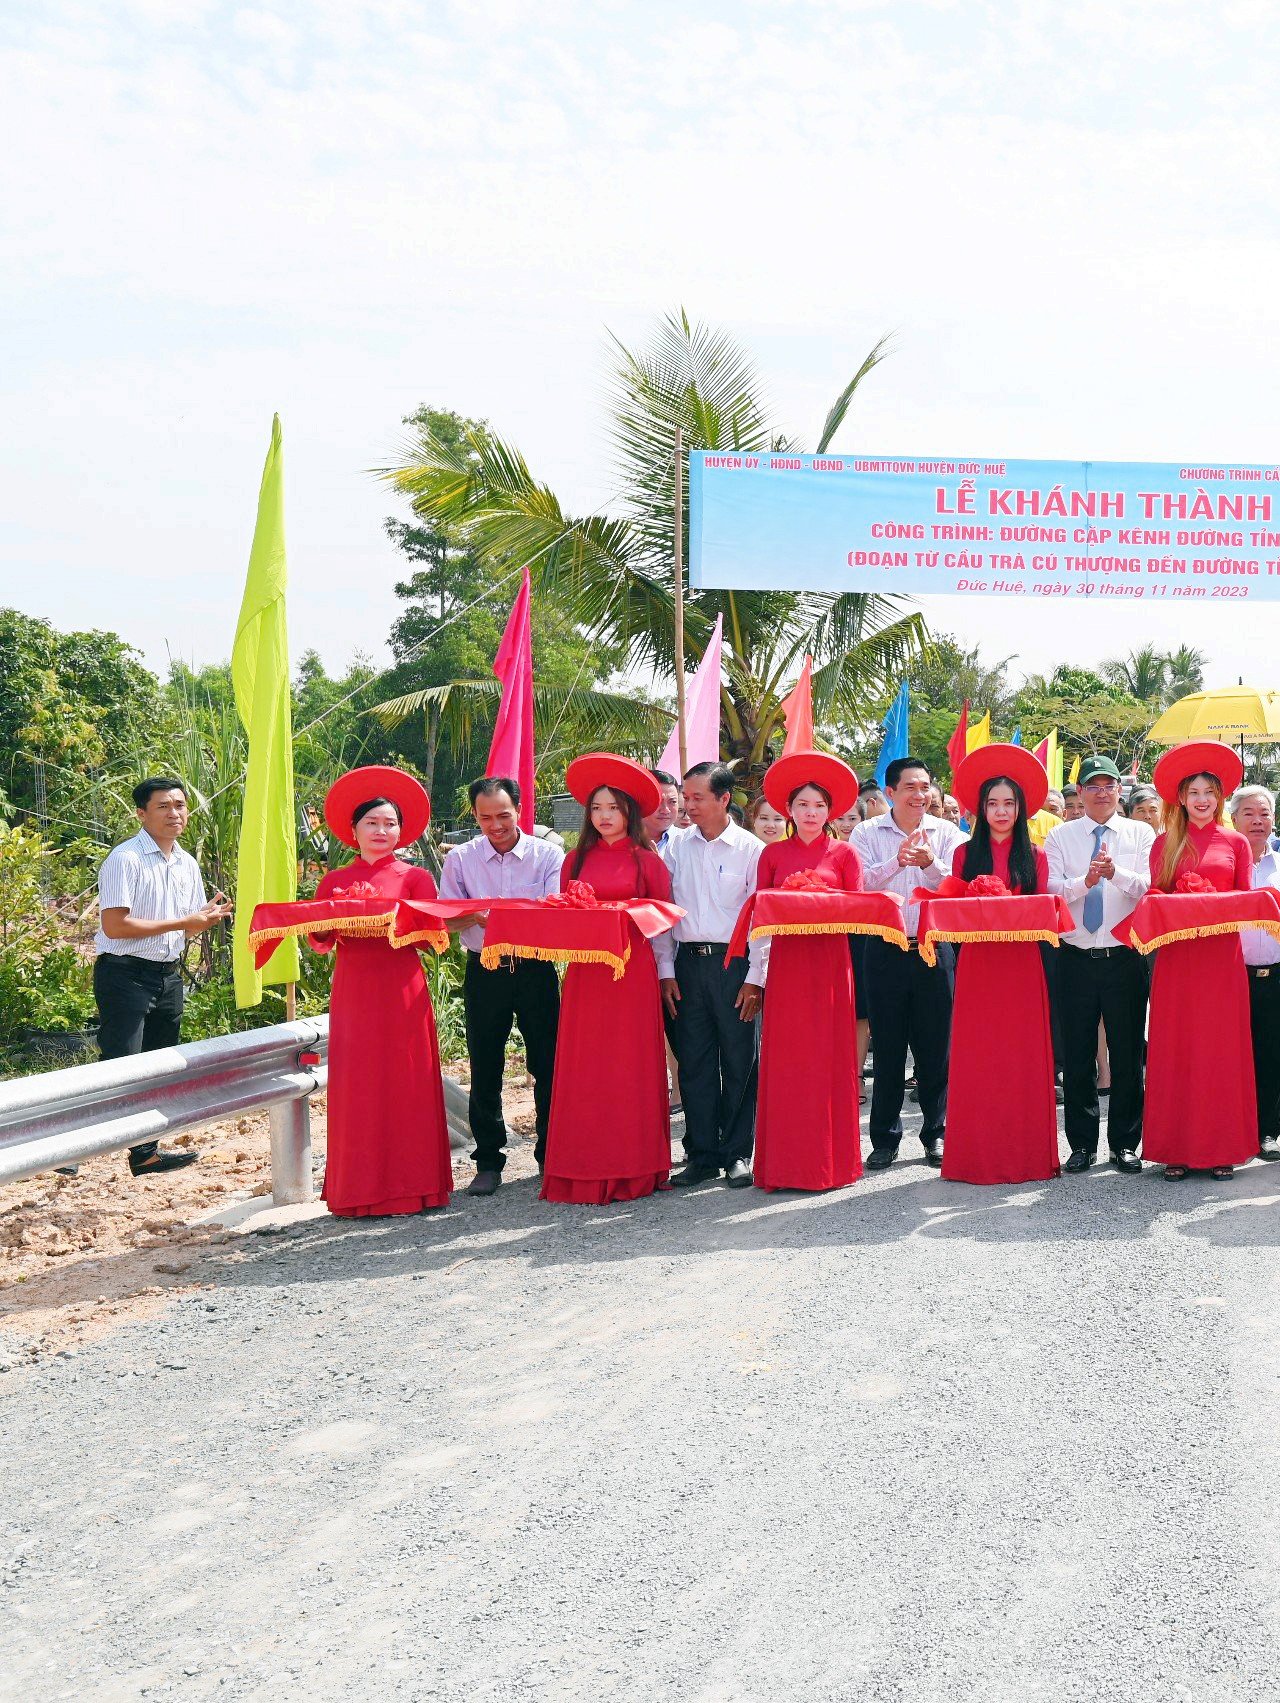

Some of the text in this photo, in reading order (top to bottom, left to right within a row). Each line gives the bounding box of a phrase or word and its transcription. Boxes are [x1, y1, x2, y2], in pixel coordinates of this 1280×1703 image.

[704, 455, 742, 470] HUYỆN
[745, 454, 759, 469] ỦY
[770, 458, 801, 470] HĐND
[812, 459, 843, 471] UBND
[854, 460, 915, 474] UBMTTQVN
[918, 460, 955, 476] HUYỆN
[957, 461, 981, 475] ĐỨC
[984, 462, 1006, 477] HUỆ
[1179, 467, 1225, 480] CHƯƠNG
[1228, 466, 1262, 481] TRÌNH
[936, 479, 1271, 521] LỄ KHÁNH THÀNH
[871, 520, 925, 539] CÔNG
[930, 523, 994, 540] TRÌNH:
[1000, 523, 1067, 543] ĐƯỜNG
[1073, 525, 1112, 546] CẶP
[1118, 527, 1171, 545] KÊNH
[1176, 528, 1243, 547] ĐƯỜNG
[847, 551, 908, 570] (ĐOẠN
[915, 550, 940, 568] TỪ
[944, 549, 983, 569] CẦU
[989, 552, 1026, 570] TRÀ
[1032, 553, 1058, 571] CÚ
[1064, 556, 1141, 576] THƯỢNG
[1146, 555, 1187, 574] ĐẾN
[1192, 557, 1259, 575] ĐƯỜNG
[956, 579, 1249, 598] Đức Huệ, ngày 30 tháng 11 năm 2023
